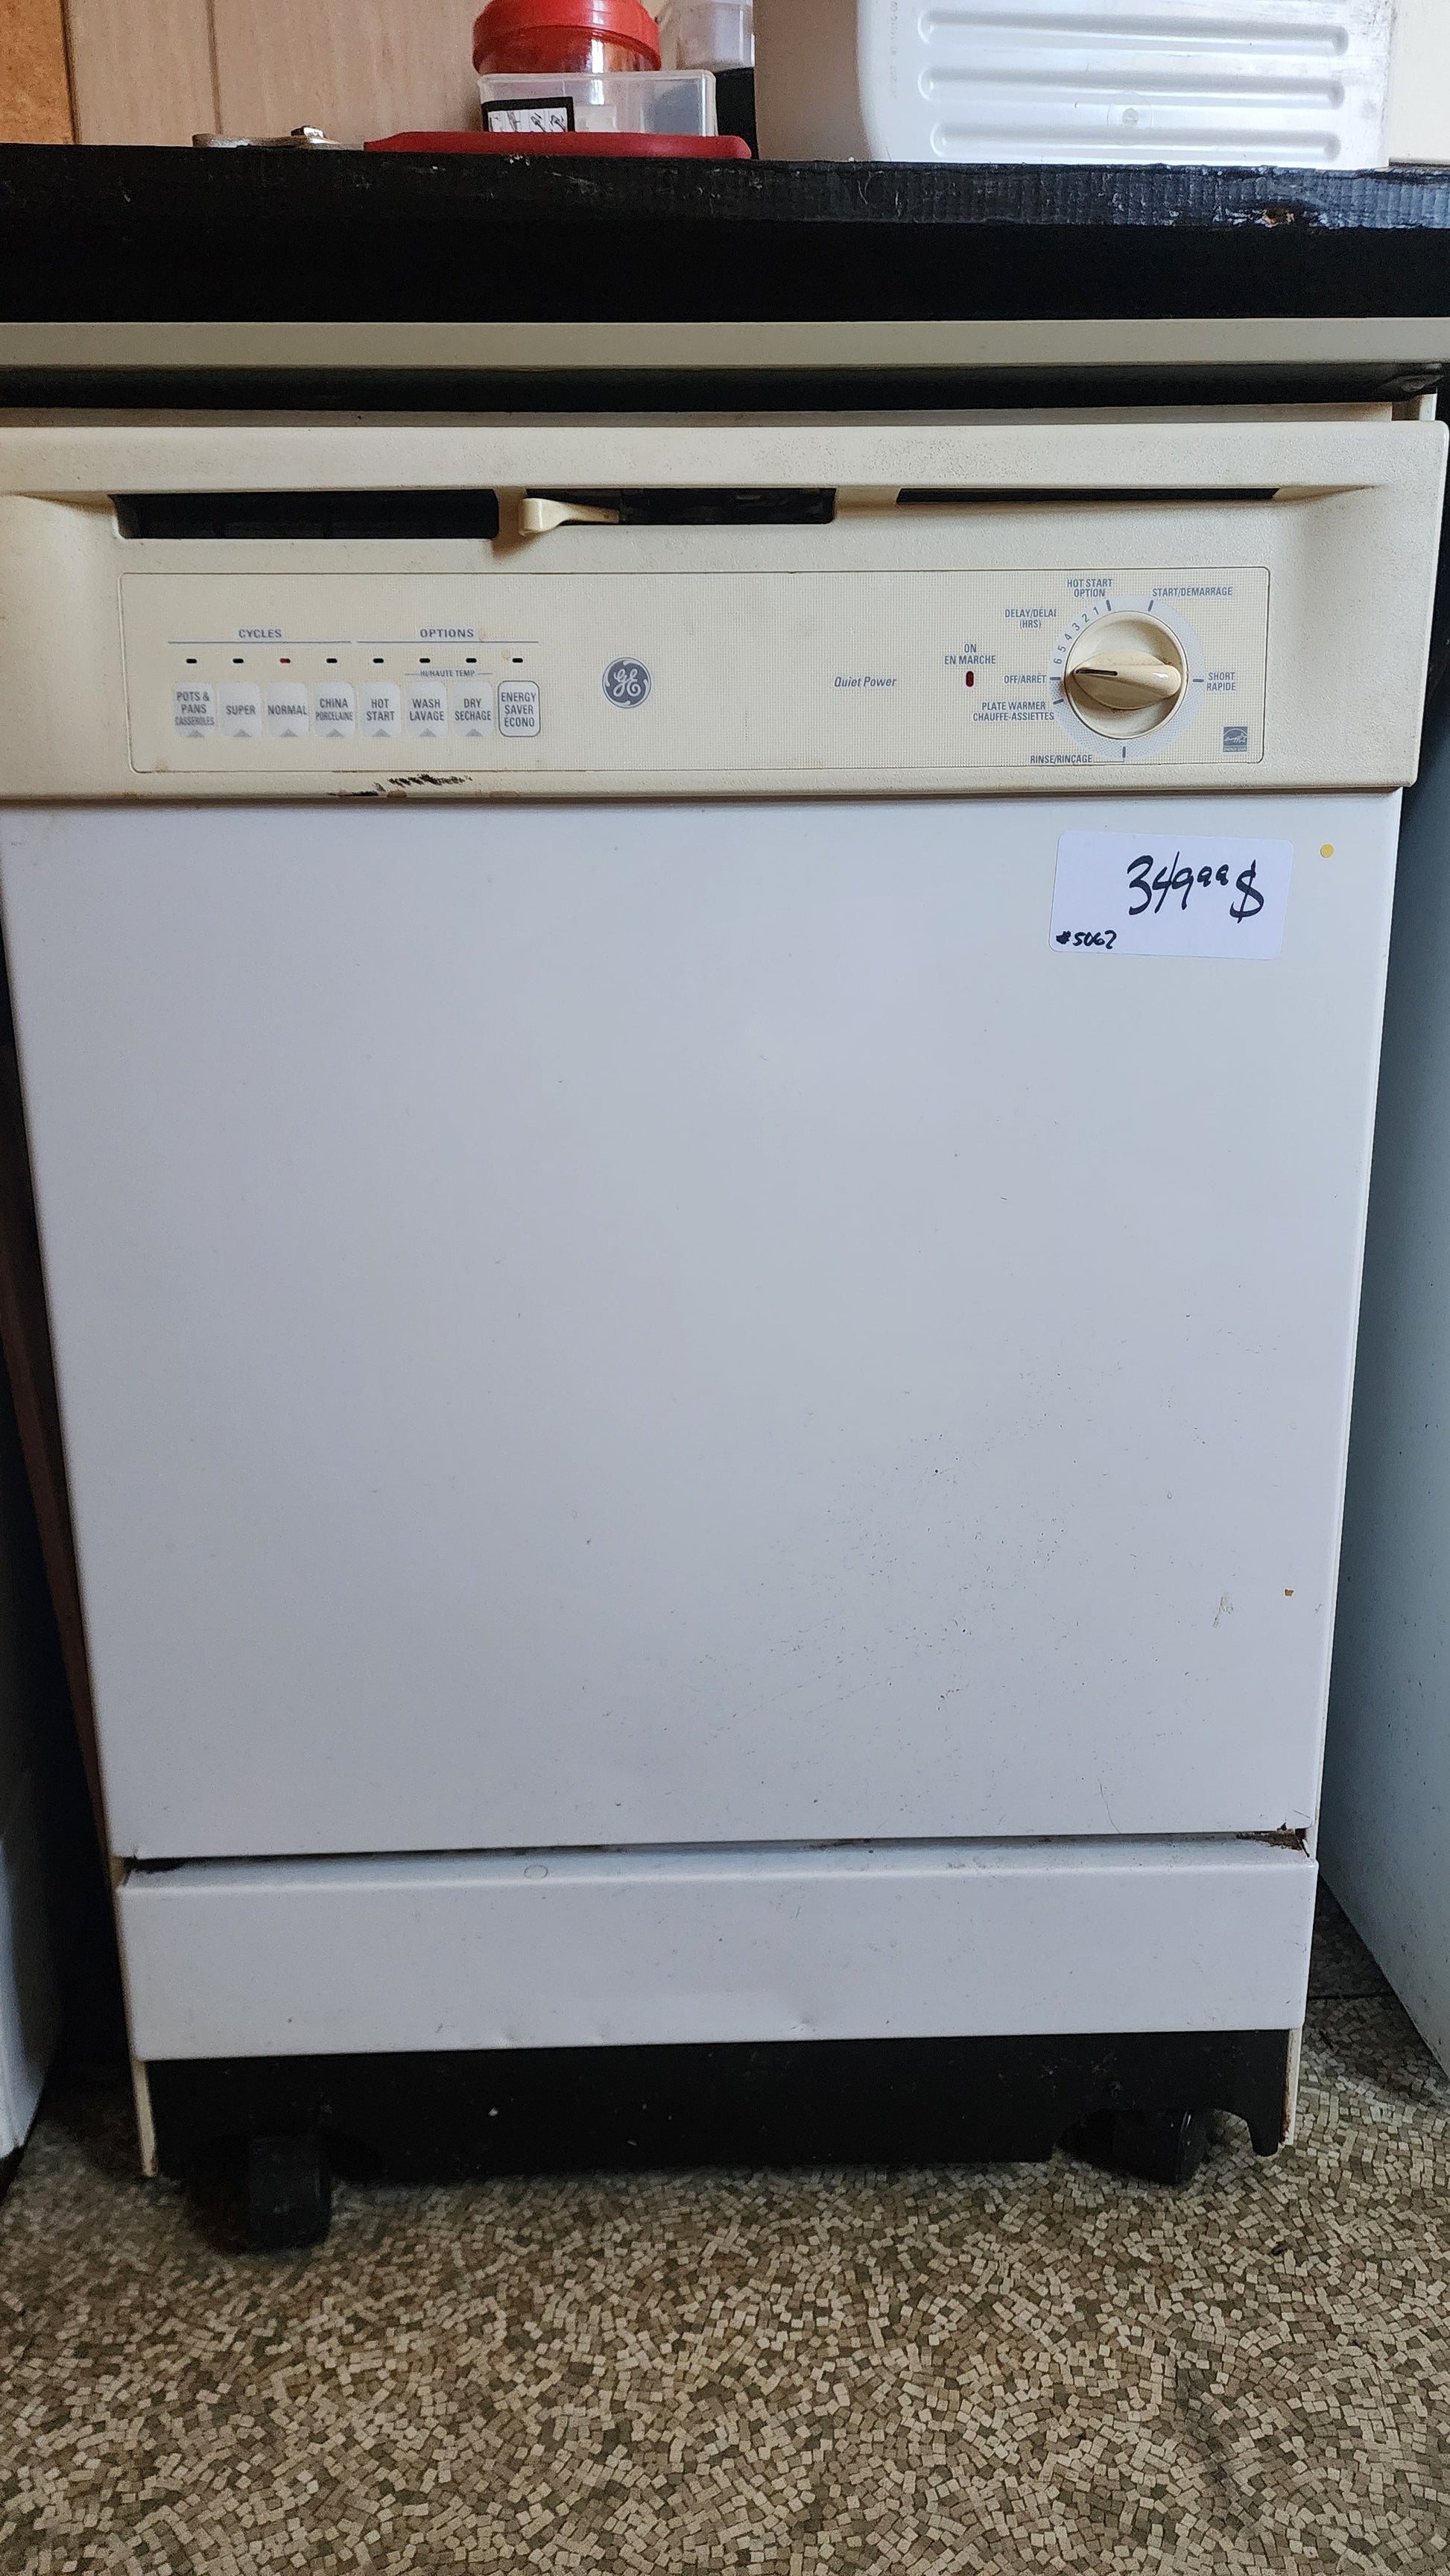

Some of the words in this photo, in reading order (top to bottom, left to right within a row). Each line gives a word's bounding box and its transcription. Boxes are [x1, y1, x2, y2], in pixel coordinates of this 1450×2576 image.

[1067, 579, 1083, 587] HOT
[1086, 579, 1112, 587] START
[1074, 589, 1105, 597] OPTION
[1093, 607, 1099, 615] 1
[1082, 613, 1089, 622] 2
[1019, 619, 1042, 629] (HRS)
[1071, 622, 1080, 631] 3
[238, 628, 282, 639] CYCLES
[420, 628, 474, 638] OPTIONS
[1064, 633, 1072, 641] 4
[963, 644, 977, 653] ON
[944, 656, 956, 665] EN
[958, 655, 996, 665] MARCHE
[834, 676, 861, 687] Quiet
[863, 676, 897, 687] Power
[1208, 672, 1235, 681] SHORT
[1206, 682, 1236, 691] RAPIDE
[176, 691, 200, 701] POTS
[202, 692, 210, 701] &
[501, 692, 536, 702] ENERGY
[319, 698, 349, 708] CHINA
[371, 698, 389, 709] HOT
[412, 698, 441, 708] WASH
[463, 698, 482, 708] DRY
[981, 702, 1006, 710] PLATE
[1008, 702, 1046, 710] WARMER
[181, 704, 207, 714] PANS
[225, 704, 256, 716] SUPER
[267, 704, 308, 716] NORMAL
[504, 704, 534, 715] SAVER
[366, 711, 395, 721] START
[409, 710, 445, 721] LAVAGE
[455, 710, 492, 721] SECHAGE
[973, 712, 1054, 722] CHAUFFE-ASSIETTES
